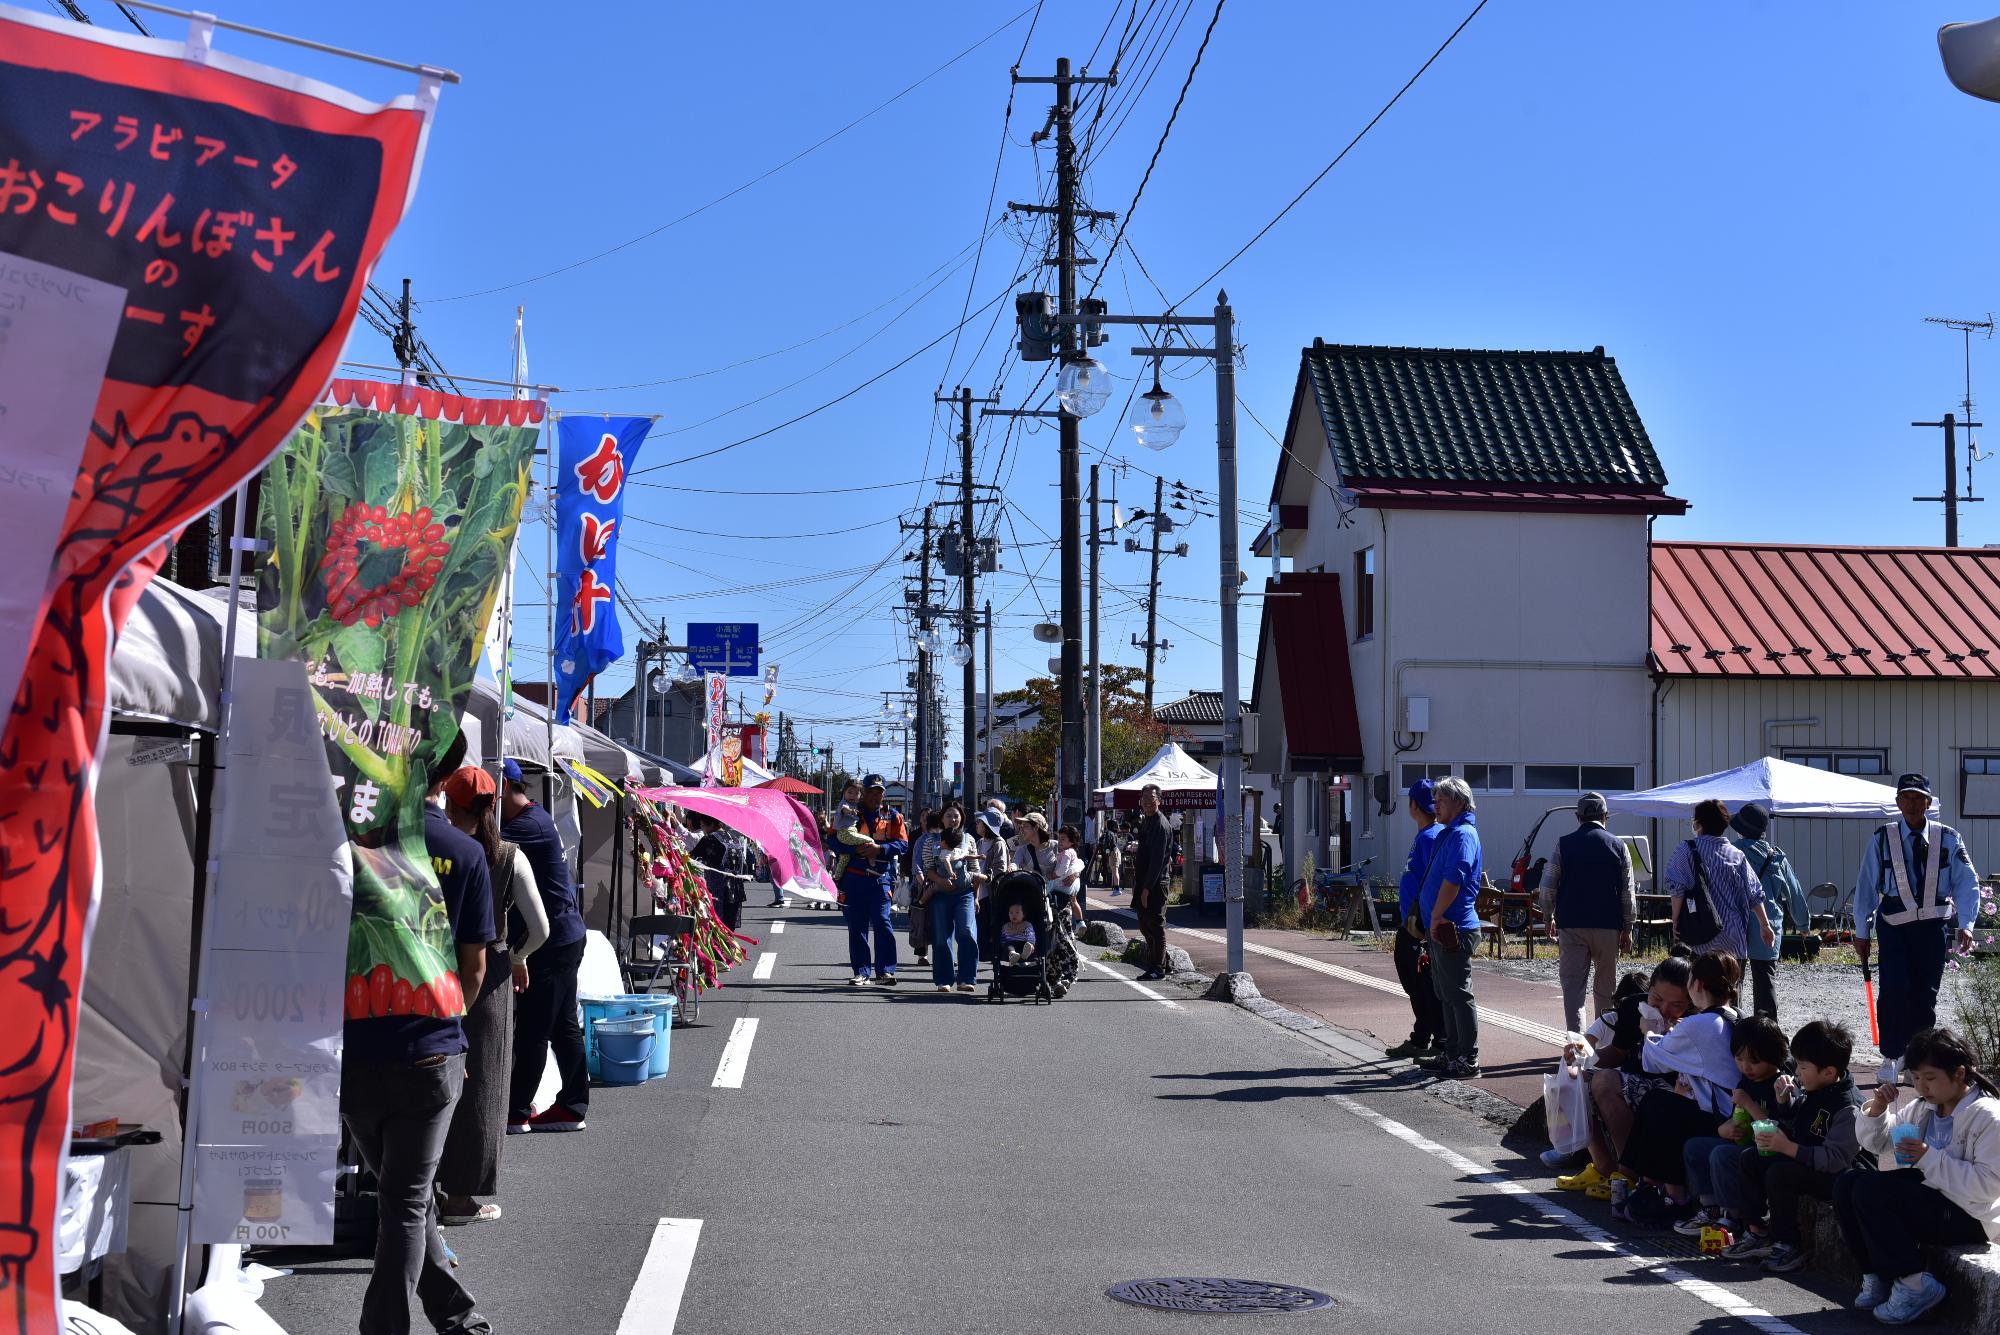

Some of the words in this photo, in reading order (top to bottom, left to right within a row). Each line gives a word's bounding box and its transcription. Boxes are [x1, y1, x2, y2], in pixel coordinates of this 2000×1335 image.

[70, 110, 297, 190] アラビアータ
[0, 158, 341, 283] おこりんぼさん
[144, 258, 179, 288] の
[375, 719, 422, 757] TOMATO
[1167, 771, 1190, 779] ISA
[1175, 798, 1203, 806] SURFING
[430, 856, 452, 875] M
